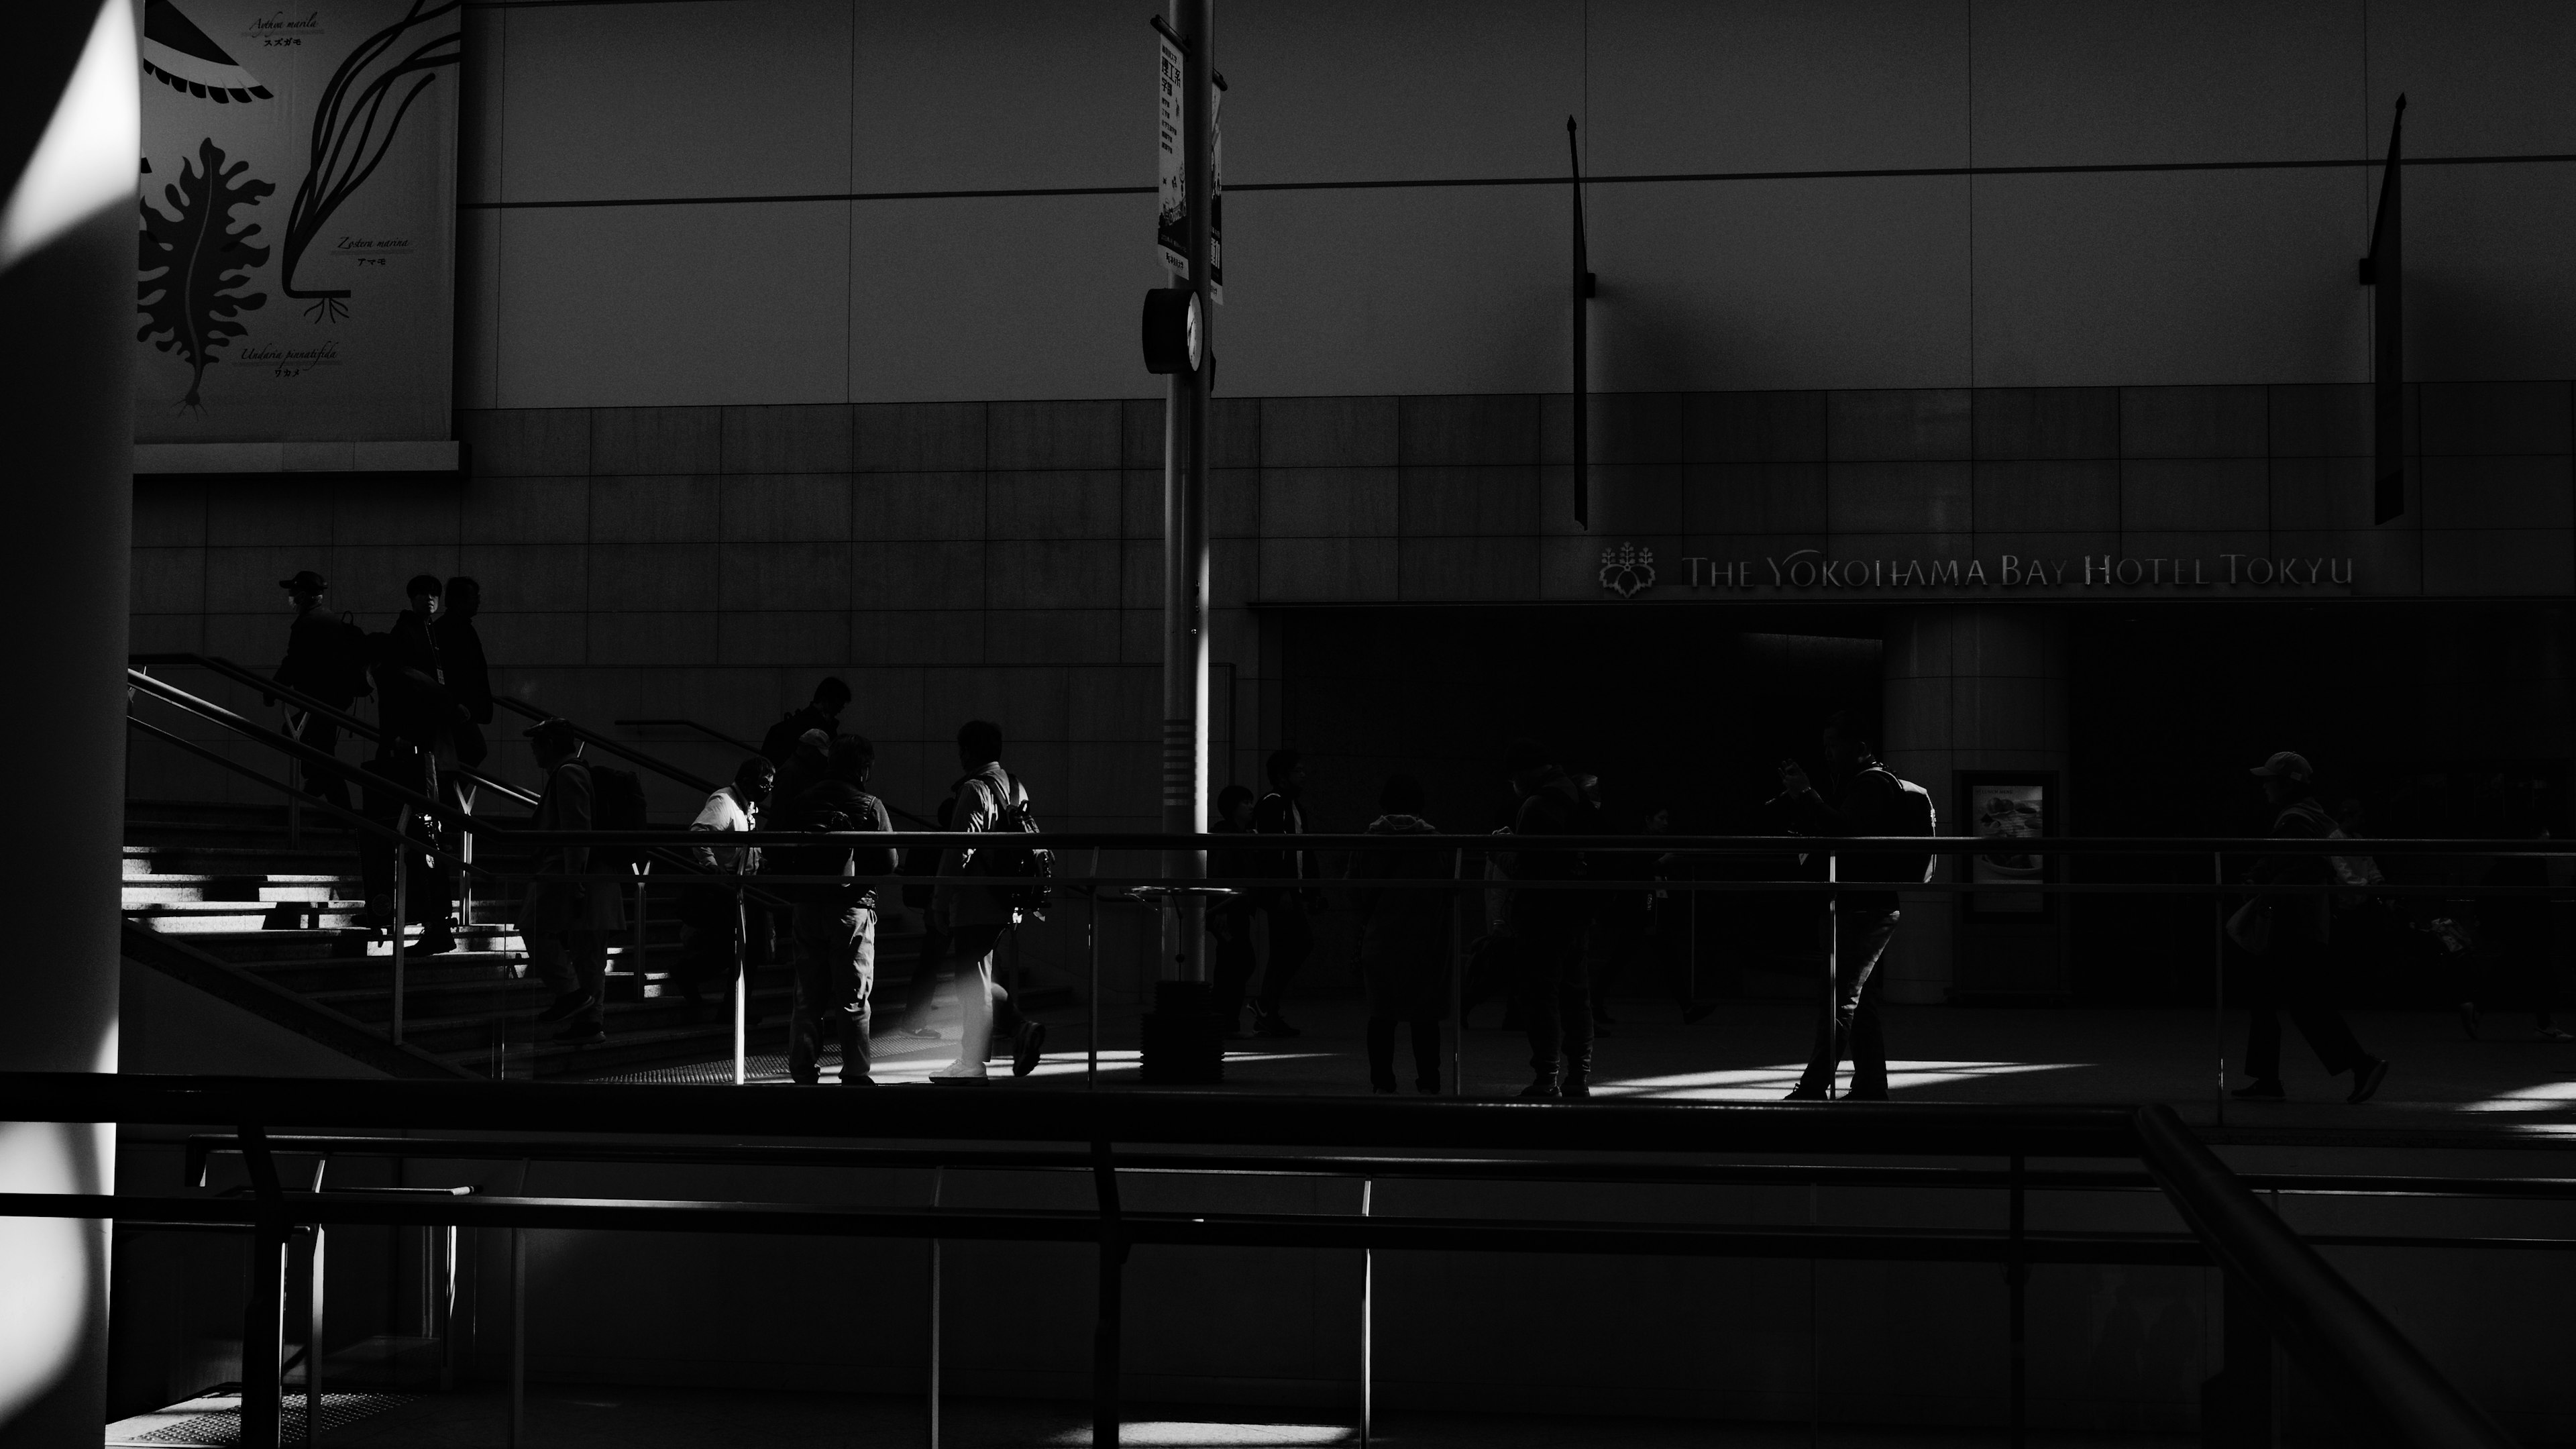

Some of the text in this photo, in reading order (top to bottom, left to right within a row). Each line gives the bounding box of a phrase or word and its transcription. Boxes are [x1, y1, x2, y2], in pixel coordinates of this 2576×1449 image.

[286, 11, 318, 28] marila
[264, 38, 301, 47] スズガモ
[1162, 56, 1181, 88] 理工系
[1162, 77, 1172, 97] 学部
[337, 237, 409, 249] Zostera marina
[358, 258, 386, 266] アマモ
[241, 341, 339, 371] Undaria pinnatifida
[275, 369, 299, 377] ワカメ
[1682, 549, 2353, 588] THE YOKOHAMA BAY HOTEL TOKYU
